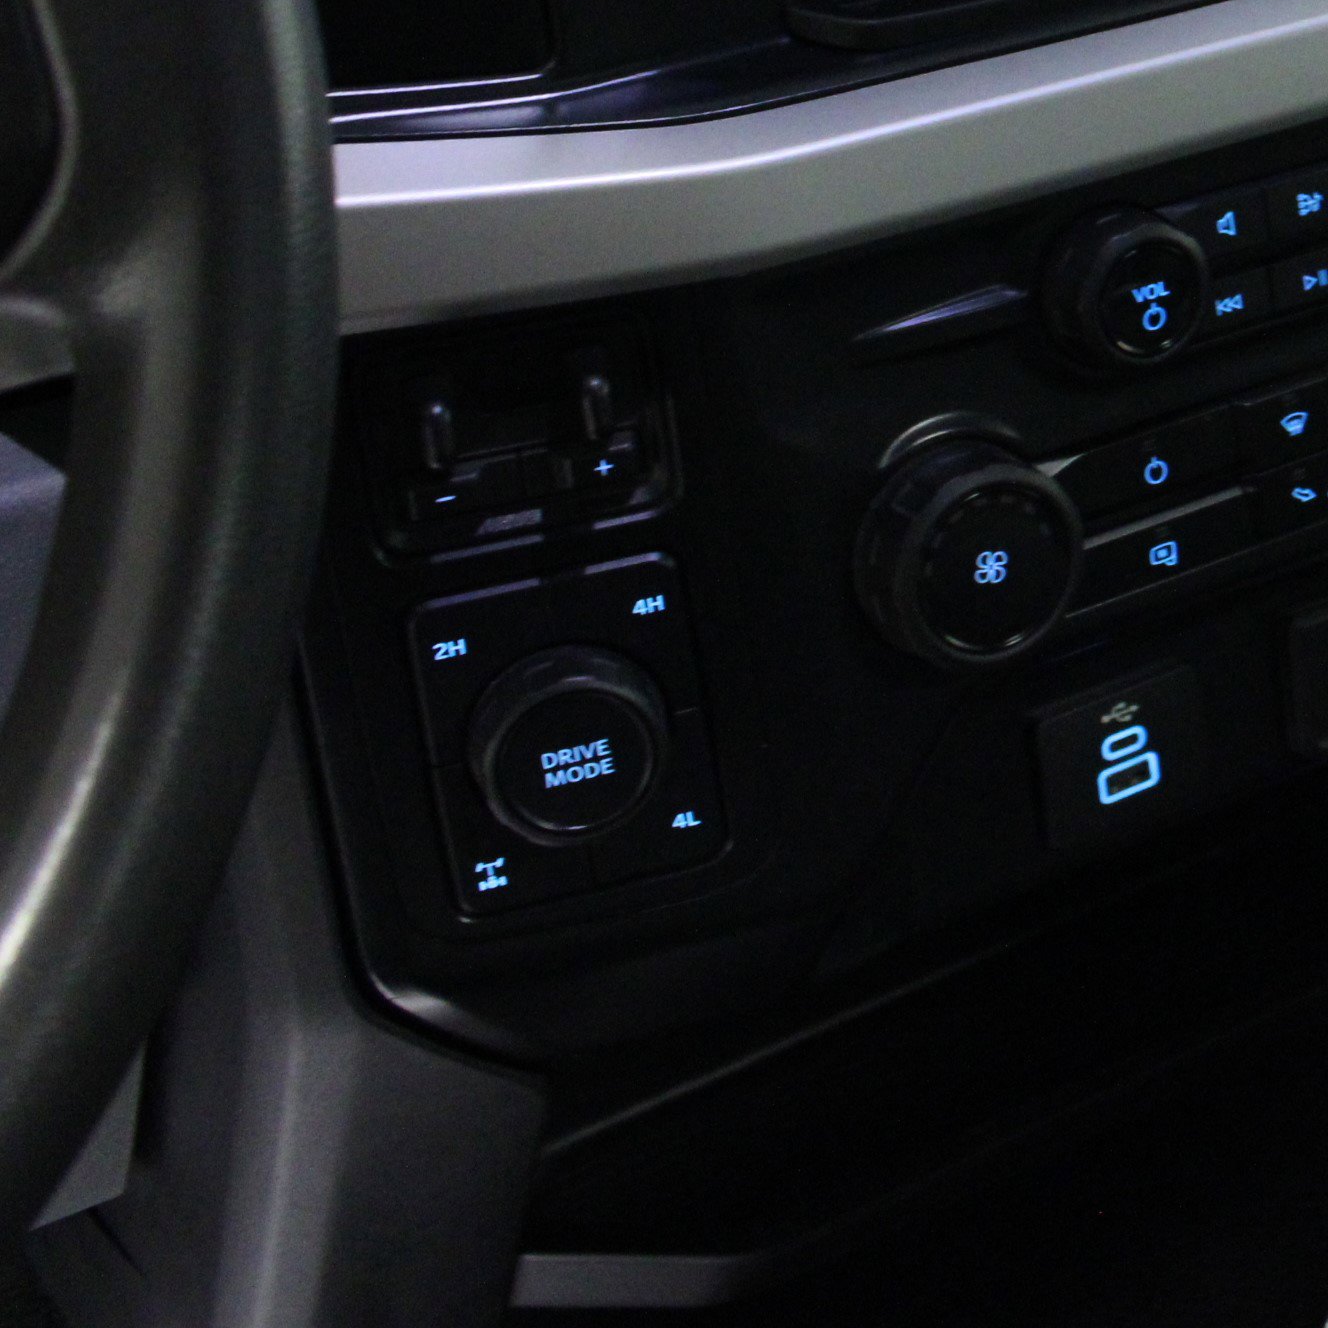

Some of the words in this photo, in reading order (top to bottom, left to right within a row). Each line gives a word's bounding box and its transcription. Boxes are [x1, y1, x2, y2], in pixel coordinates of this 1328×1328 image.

[1131, 281, 1170, 303] VOL
[632, 595, 666, 616] 4H
[432, 638, 468, 661] 2H
[540, 739, 611, 771] DRIVE
[545, 758, 615, 789] MODE
[672, 812, 702, 830] 4L
